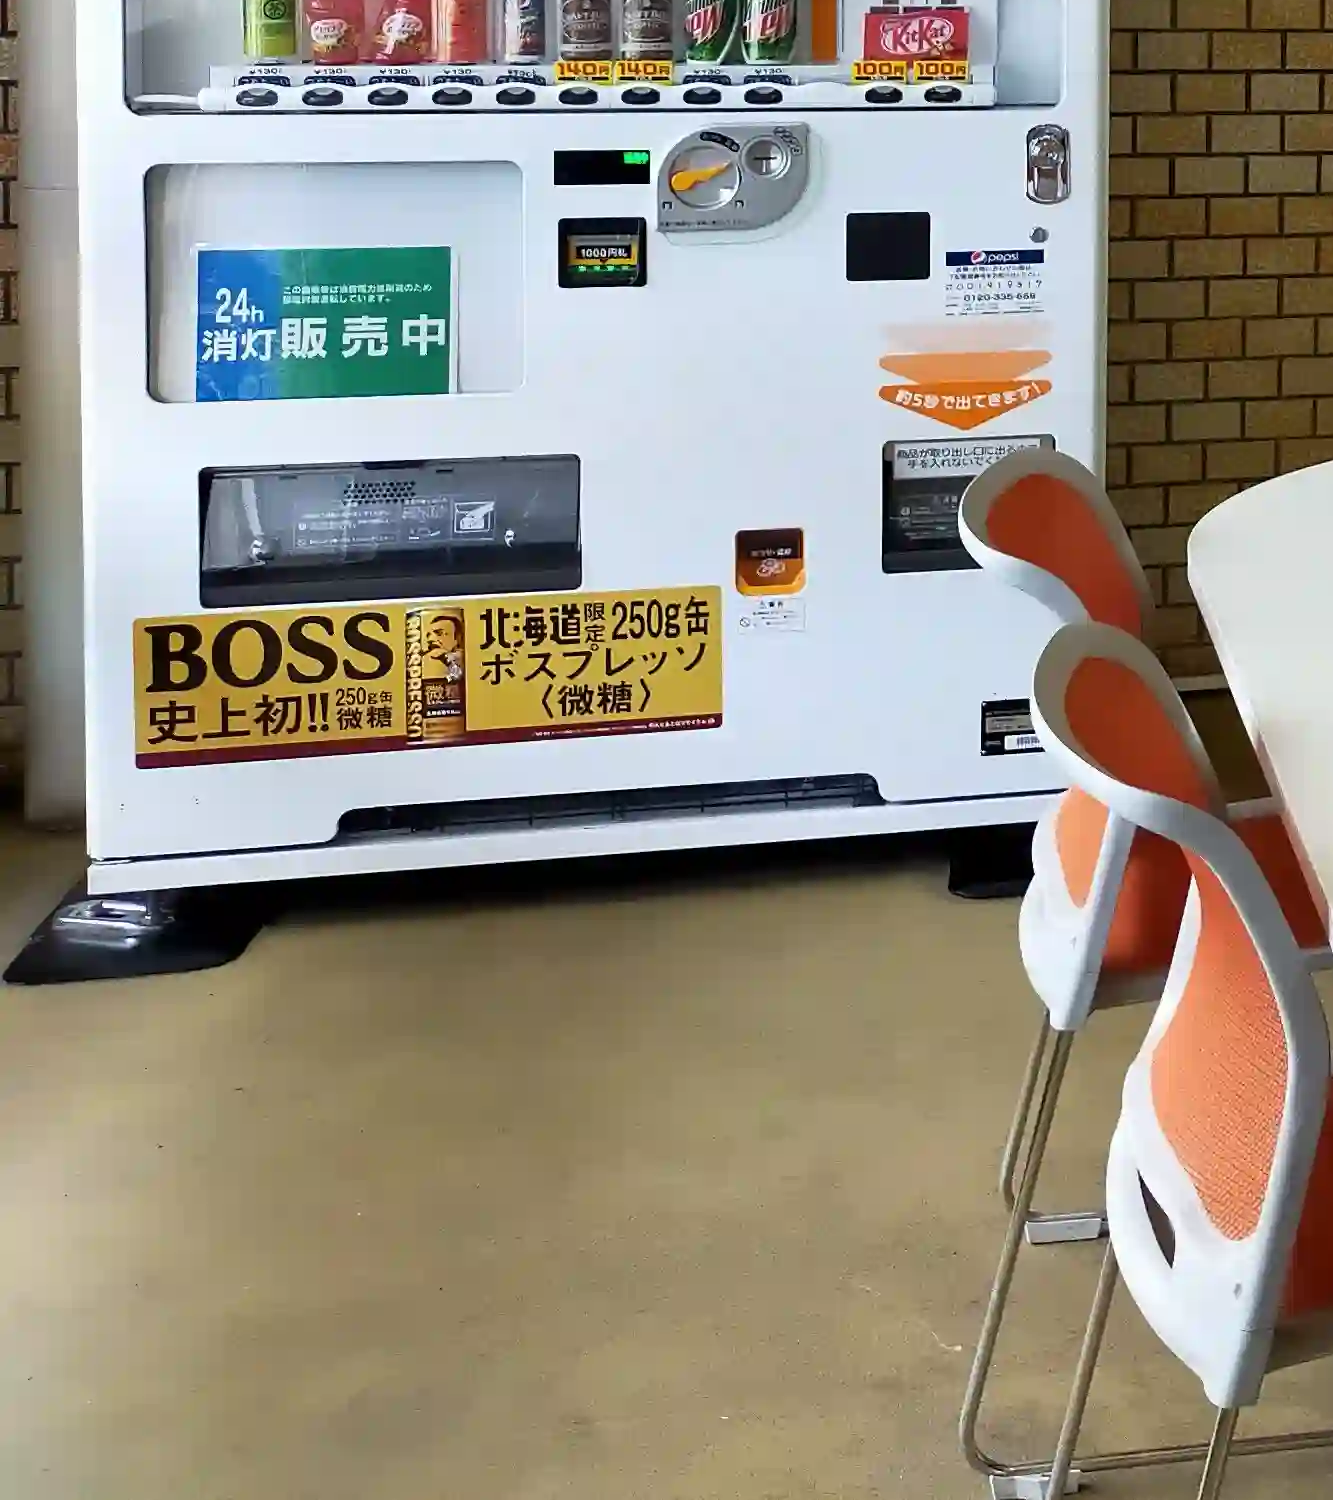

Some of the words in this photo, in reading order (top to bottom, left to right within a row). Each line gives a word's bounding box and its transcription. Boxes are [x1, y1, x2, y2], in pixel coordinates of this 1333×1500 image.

[891, 18, 947, 52] KitKat
[558, 62, 610, 76] 140円
[619, 62, 670, 76] 140円
[855, 62, 905, 76] 100円
[916, 61, 967, 76] 100円
[580, 246, 629, 259] 1000円札
[987, 252, 1020, 263] pepsi
[214, 286, 265, 325] 24h
[201, 327, 277, 362] 消灯
[280, 313, 446, 359] 販売中
[907, 455, 1000, 469] 手を入れないでく
[479, 603, 581, 650] 北海道
[611, 595, 710, 641] 250g缶
[143, 611, 394, 693] BOSS
[479, 641, 707, 685] ボスプレッソ
[335, 686, 393, 707] 250g缶
[336, 706, 393, 730] 微糖
